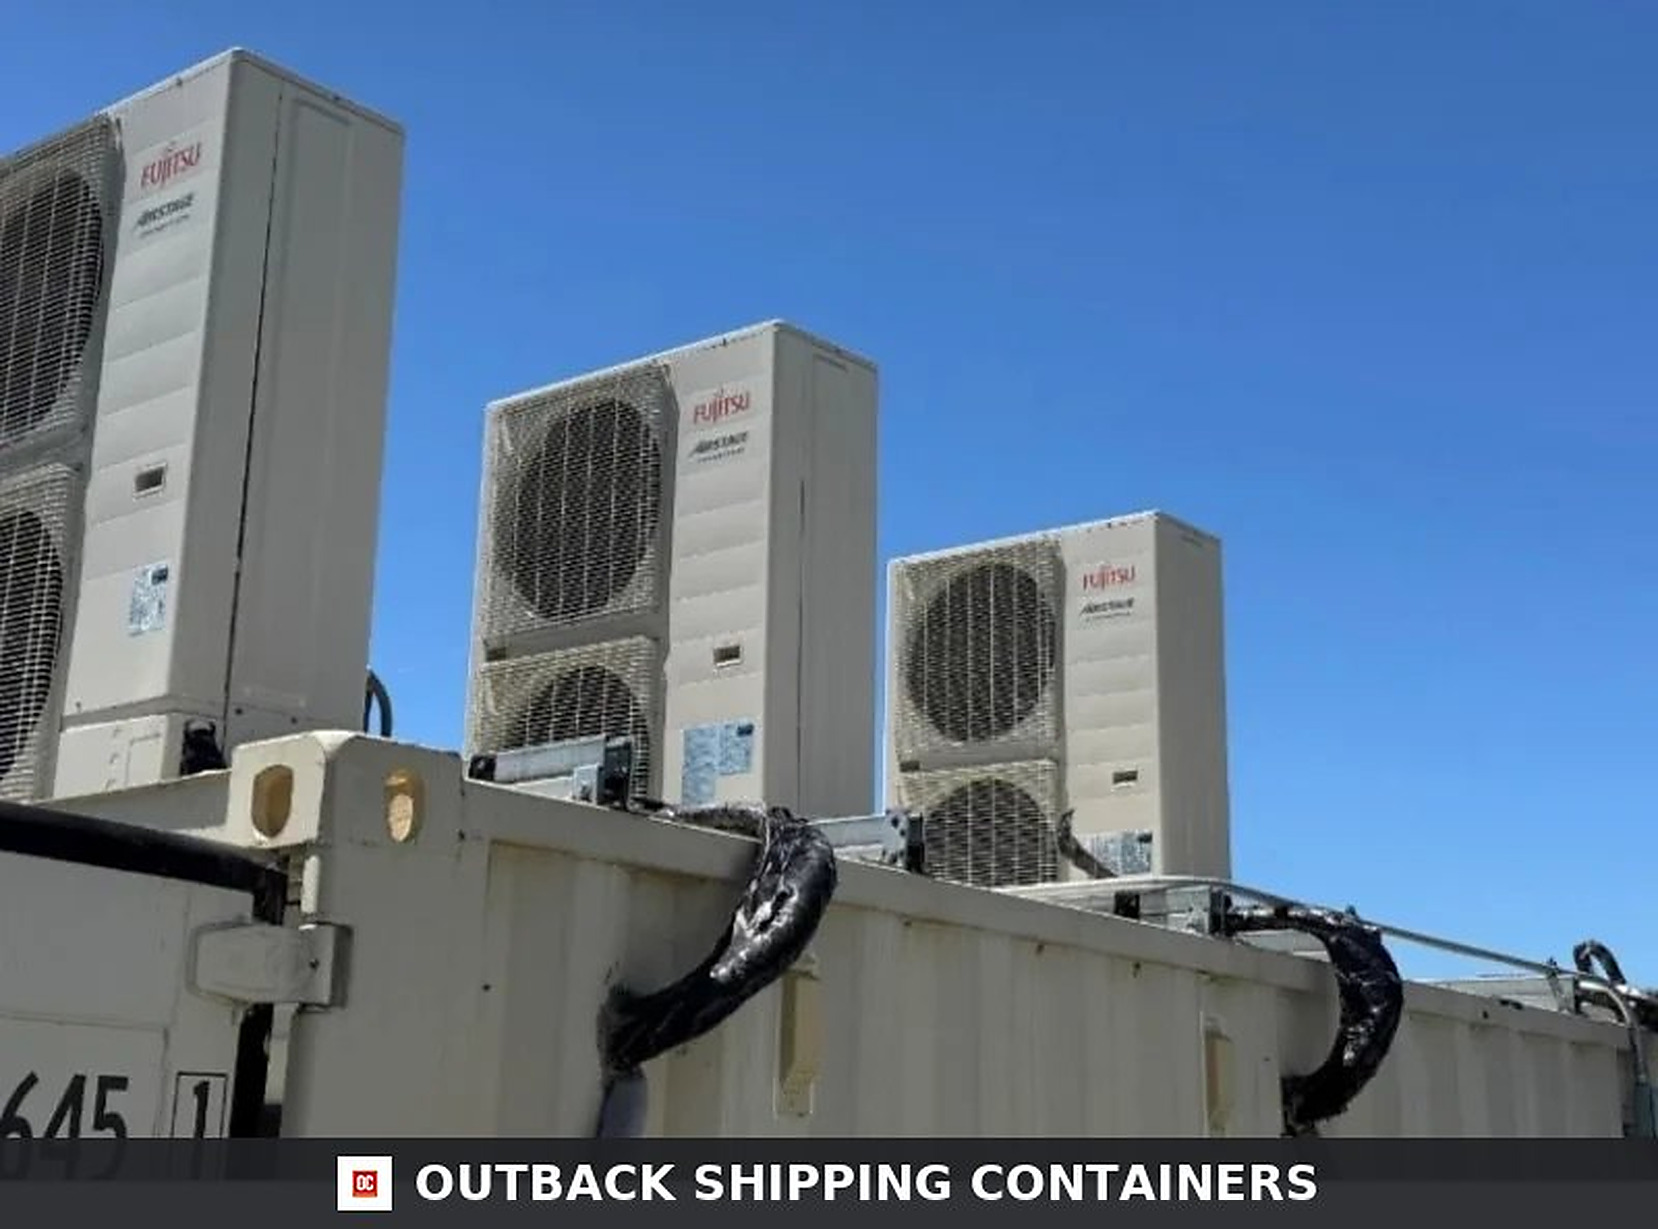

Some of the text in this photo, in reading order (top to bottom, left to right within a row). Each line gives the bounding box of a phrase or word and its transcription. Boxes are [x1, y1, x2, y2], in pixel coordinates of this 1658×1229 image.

[140, 142, 202, 189] FUJITSU
[693, 387, 751, 424] FUJITSU
[1082, 564, 1136, 591] FUJITSU
